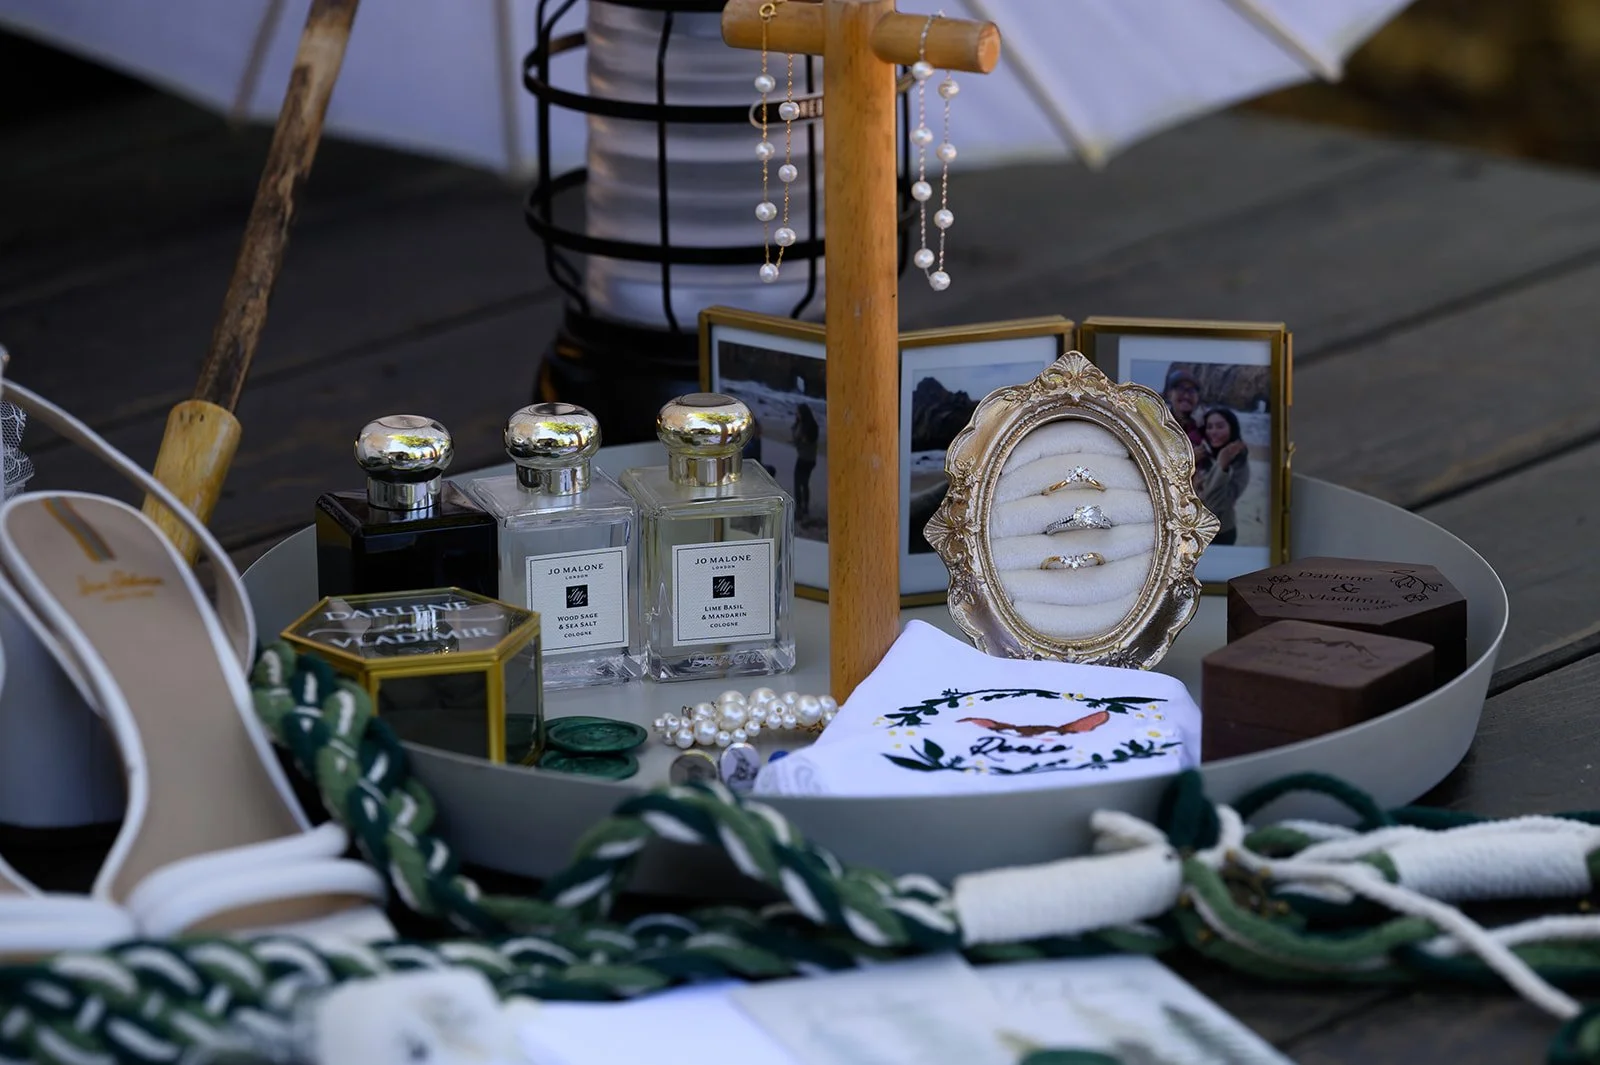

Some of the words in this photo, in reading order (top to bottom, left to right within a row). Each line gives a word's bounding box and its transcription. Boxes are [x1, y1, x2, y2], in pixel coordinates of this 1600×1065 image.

[695, 557, 707, 565] JO
[709, 554, 752, 564] MALONE
[548, 567, 560, 576] JO
[562, 563, 604, 574] MALONE
[1331, 583, 1360, 593] &
[324, 601, 472, 621] DARLENE
[708, 612, 747, 620] MANDARIN
[557, 614, 579, 622] WOOD
[580, 612, 598, 620] SAGE
[580, 620, 597, 628] SALT
[331, 627, 499, 649] VLADIMIR
